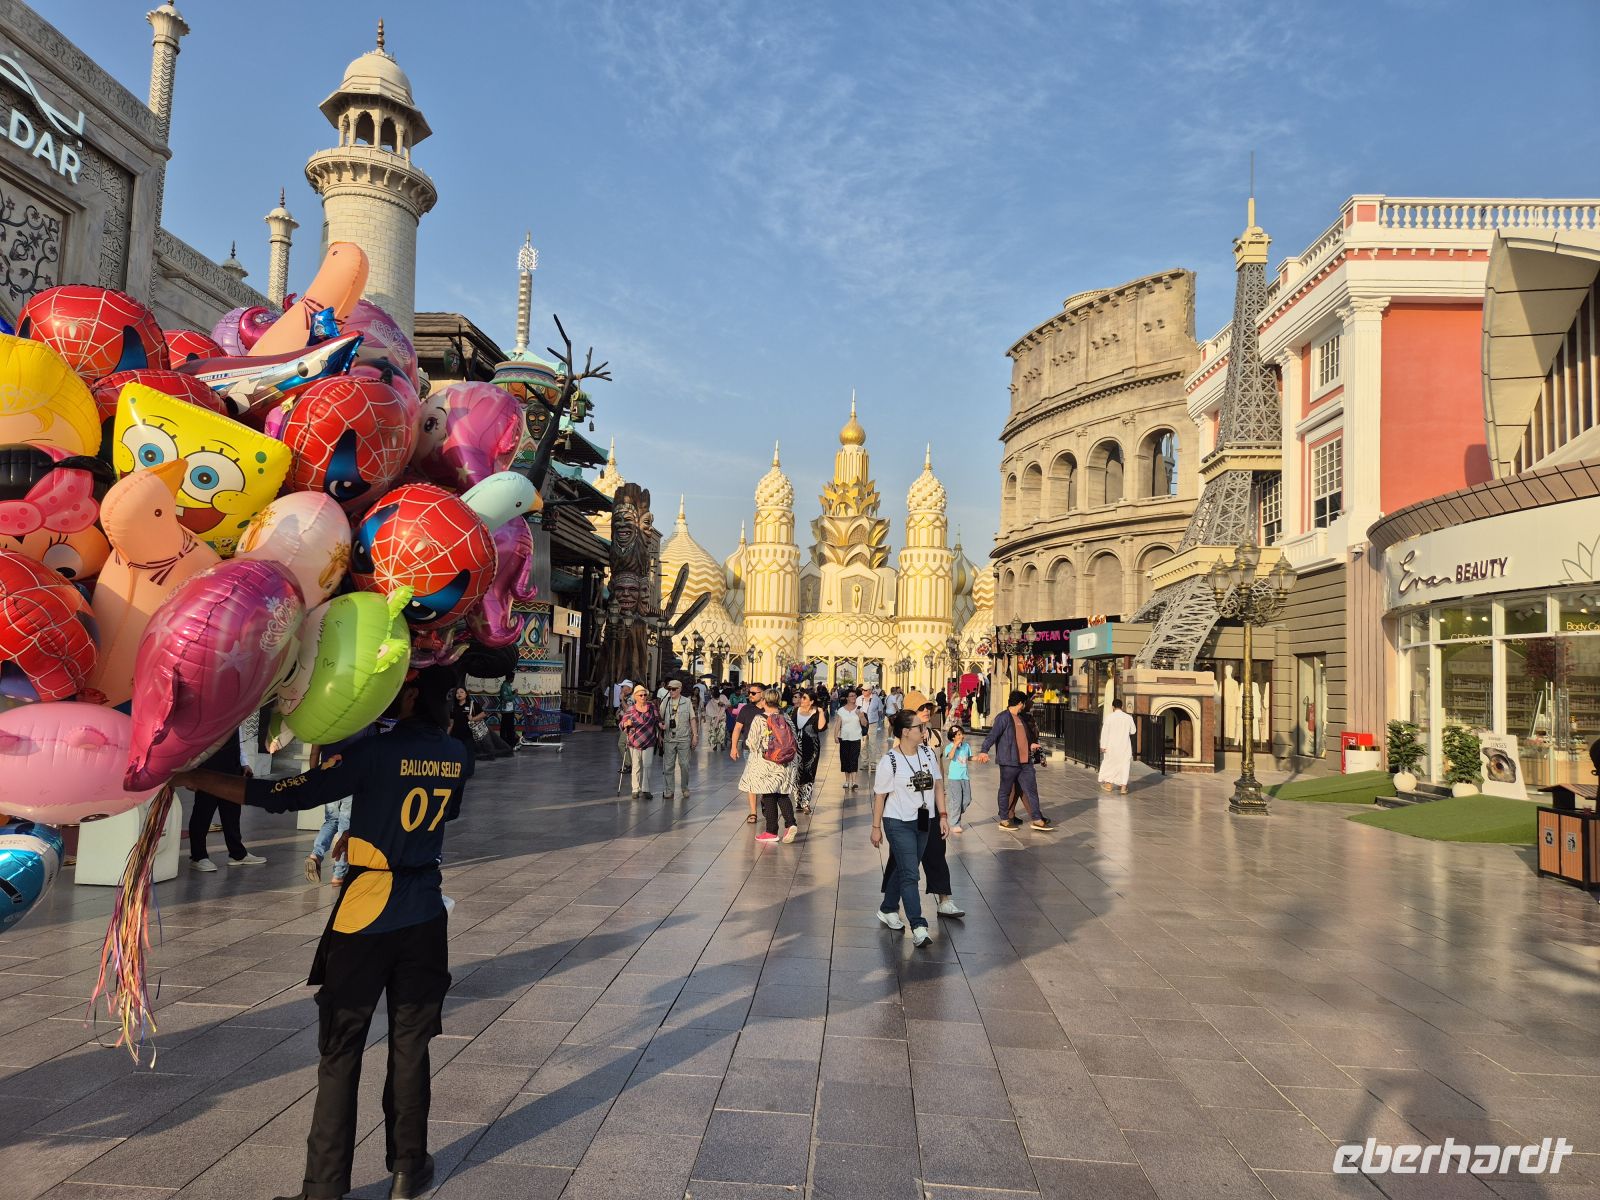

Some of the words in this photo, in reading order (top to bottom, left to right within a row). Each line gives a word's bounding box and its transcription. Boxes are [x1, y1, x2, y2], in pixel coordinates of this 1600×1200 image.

[1455, 557, 1508, 583] BEAUTY
[1566, 621, 1588, 632] Body
[400, 759, 440, 777] BALLOON
[441, 761, 462, 778] SELLER
[400, 787, 452, 833] 07
